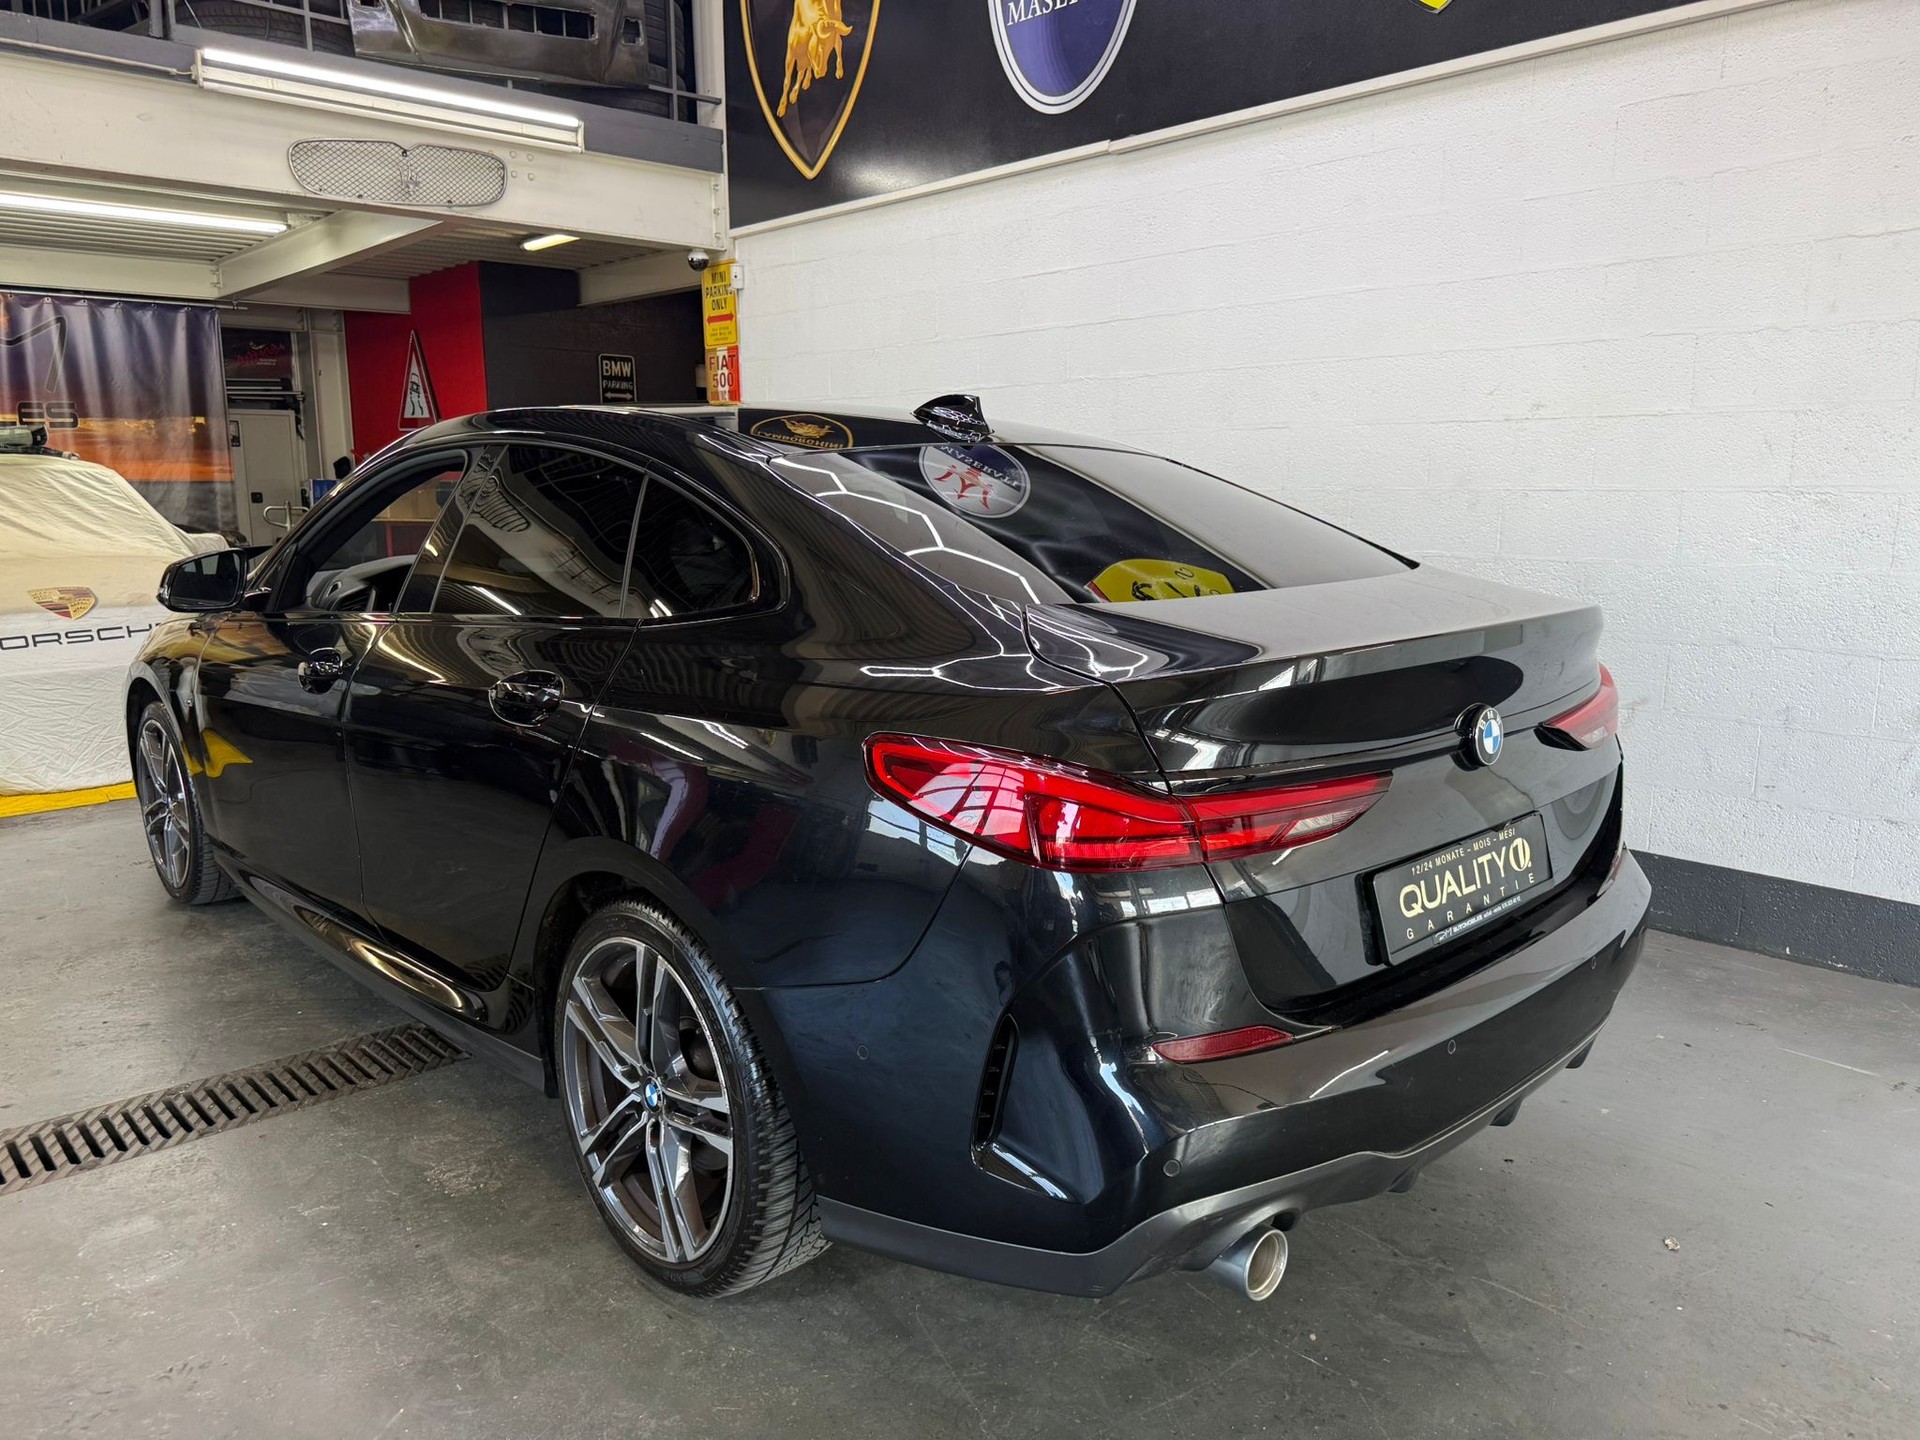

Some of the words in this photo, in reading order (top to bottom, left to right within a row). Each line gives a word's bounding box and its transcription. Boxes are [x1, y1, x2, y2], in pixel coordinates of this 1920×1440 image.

[1007, 0, 1078, 26] MAS
[711, 271, 726, 285] MINI
[711, 297, 727, 311] ONLY
[603, 360, 631, 377] BMW
[709, 354, 736, 371] FIAT
[603, 379, 634, 390] PARKING
[712, 371, 734, 389] 500
[0, 622, 161, 650] ORSCH
[1411, 860, 1433, 876] 12/24
[1435, 848, 1465, 867] MONATE
[1473, 838, 1491, 851] MOIS
[1499, 828, 1516, 841] MESI
[1399, 846, 1507, 918] QUALITY
[1406, 872, 1535, 940] GARANTIE
